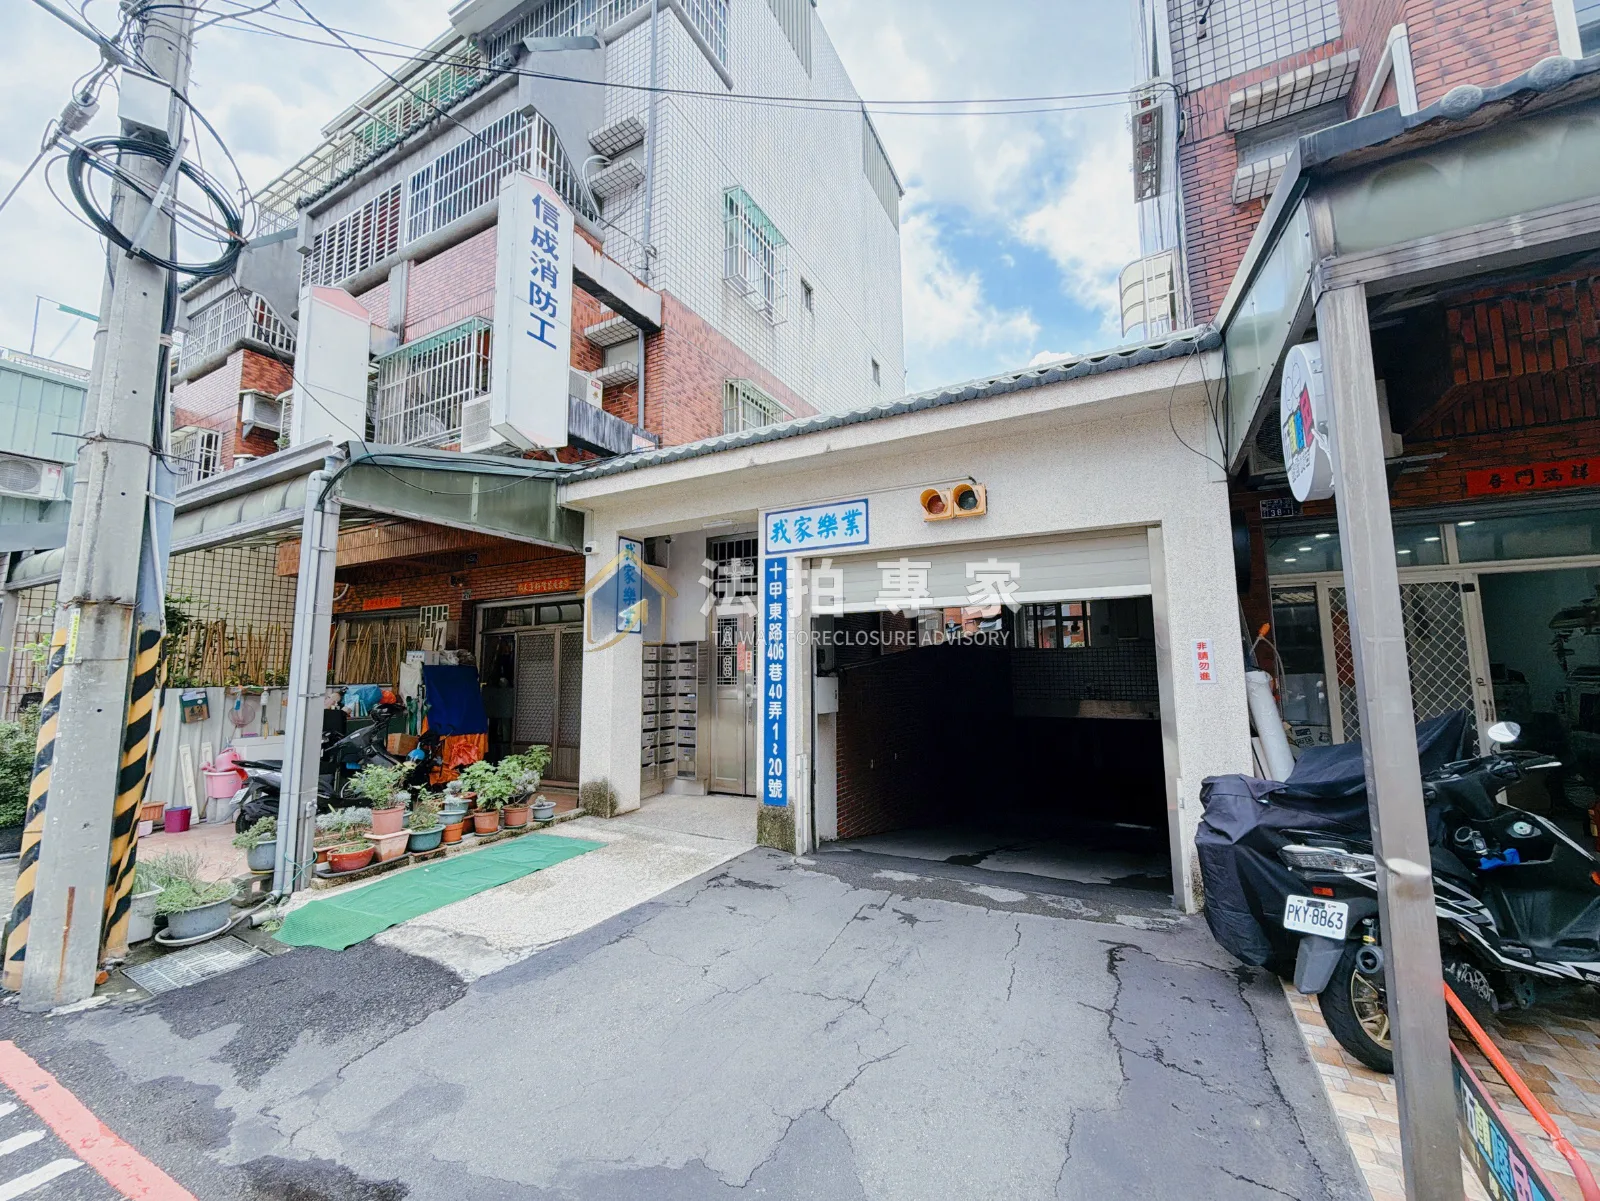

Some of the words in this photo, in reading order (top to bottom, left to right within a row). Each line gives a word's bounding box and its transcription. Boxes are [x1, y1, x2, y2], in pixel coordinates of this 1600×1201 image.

[527, 193, 560, 350] 信成消防工
[770, 508, 863, 544] 我家樂業
[1196, 642, 1211, 680] 非請勿進
